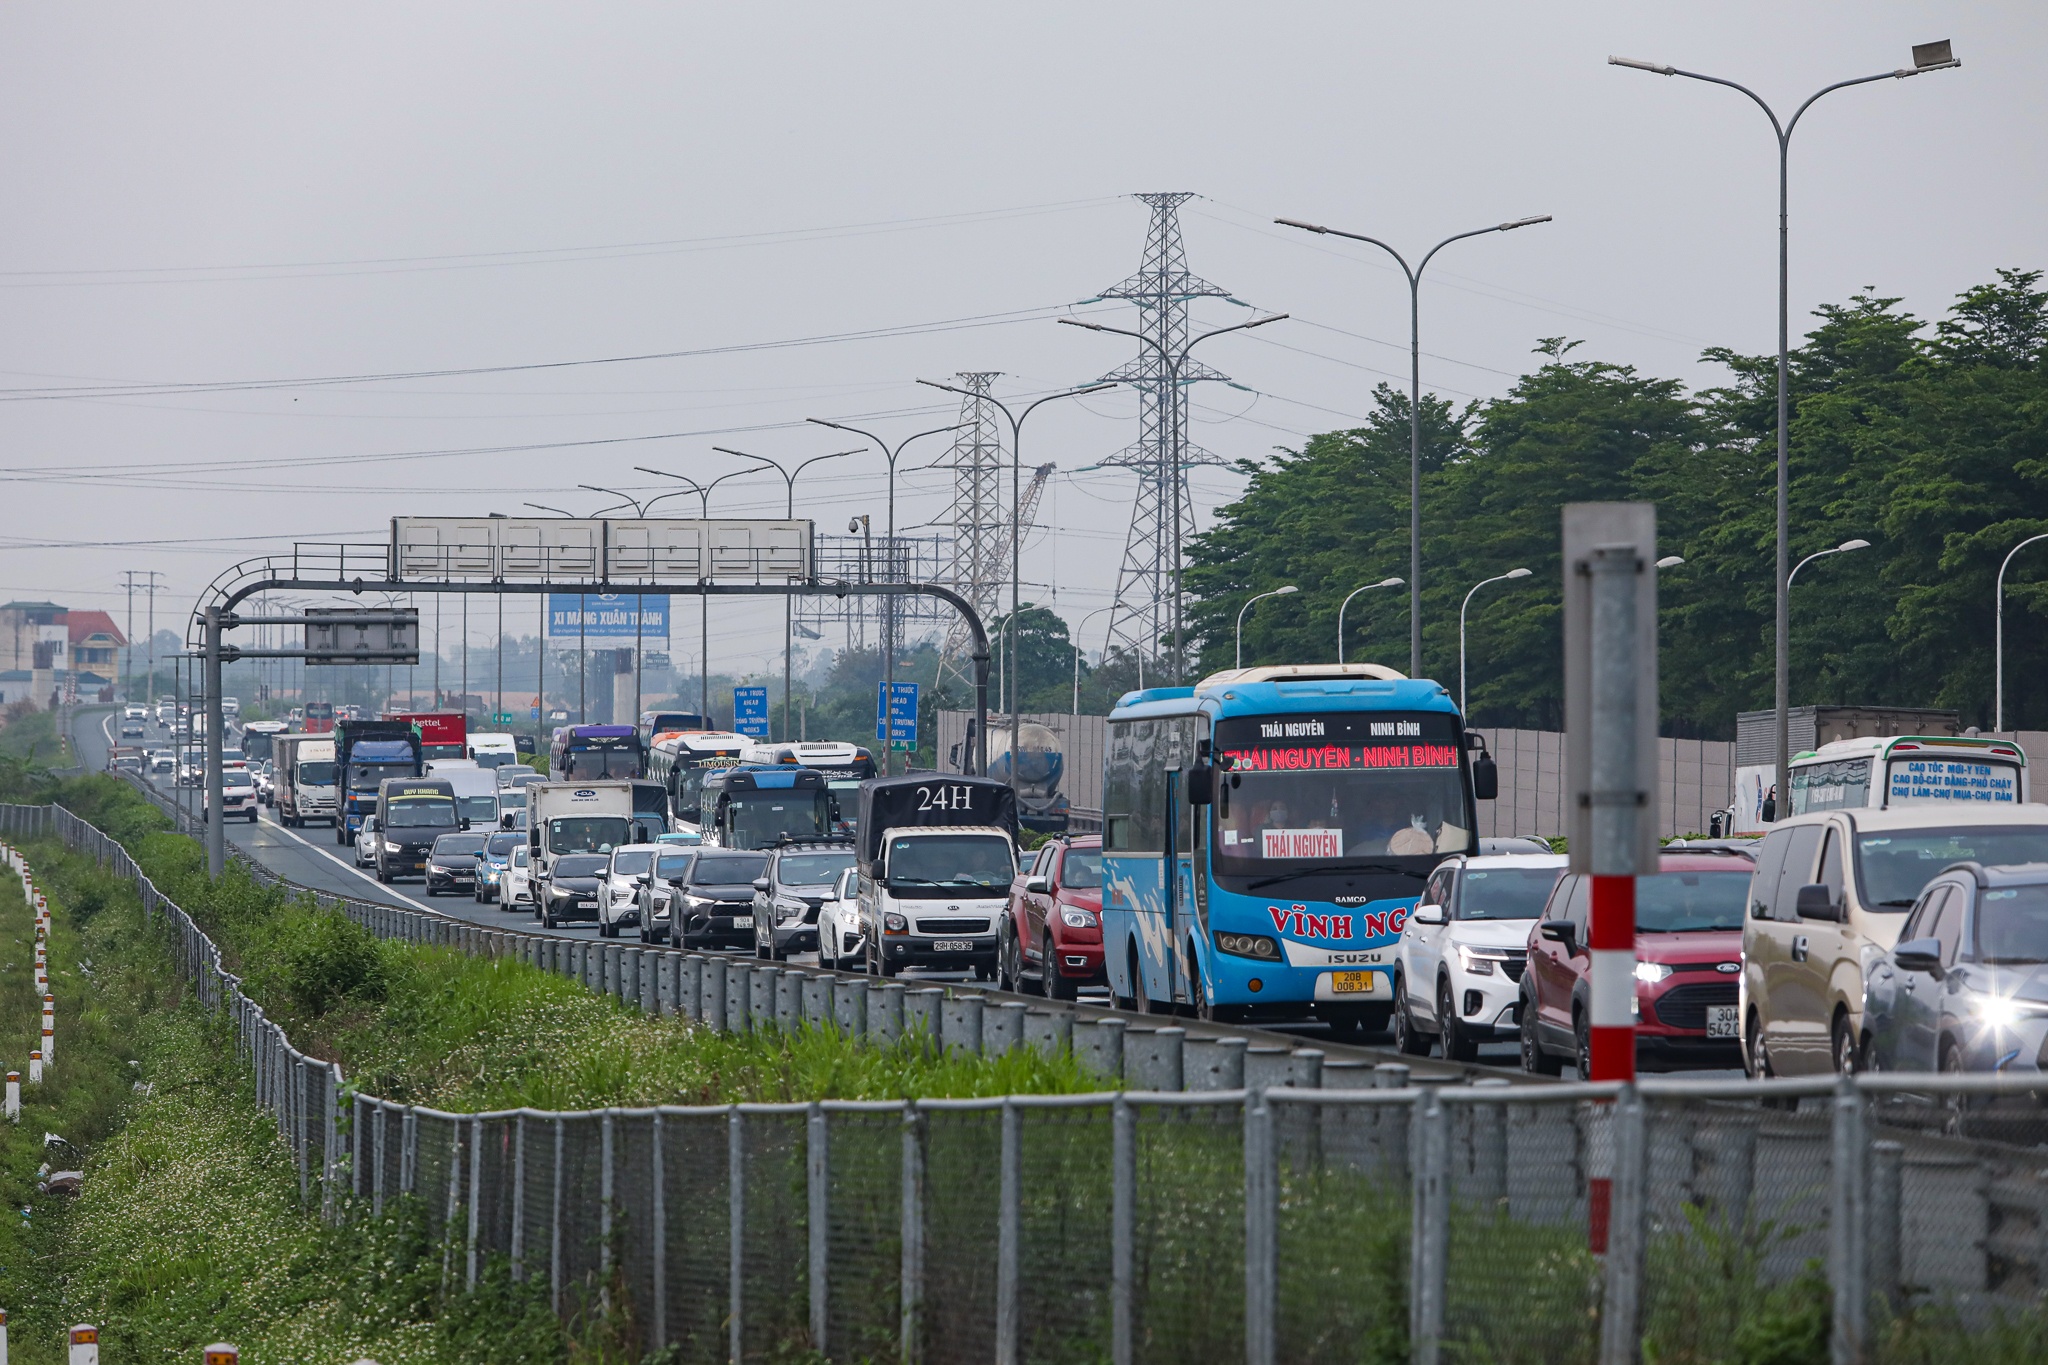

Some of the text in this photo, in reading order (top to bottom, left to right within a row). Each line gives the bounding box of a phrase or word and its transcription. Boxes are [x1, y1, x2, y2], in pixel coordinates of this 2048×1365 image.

[554, 611, 564, 625] XI
[600, 609, 627, 625] XUÂN
[1260, 719, 1420, 738] THÁI NGUYÊN NINH BÌNH
[1271, 743, 1350, 770] NGUYÊN
[1364, 746, 1408, 768] NINH
[1412, 741, 1457, 767] BÌNH
[699, 760, 740, 768] LIMOUSIN
[1908, 762, 1925, 772] CAO
[1893, 774, 1910, 783] CAO
[1990, 778, 2012, 789] CHÁY
[916, 786, 973, 811] 24H
[1892, 786, 1909, 798] CHỢ
[1912, 786, 1950, 799] LÂM-CHỢ
[1266, 830, 1337, 858] THÁI NGUYÊN
[1268, 904, 1411, 939] VĨNH NG
[1328, 954, 1382, 964] ISUZU
[1344, 973, 1361, 982] 20B
[1336, 982, 1369, 991] 008.31
[1718, 1008, 1739, 1022] 30A
